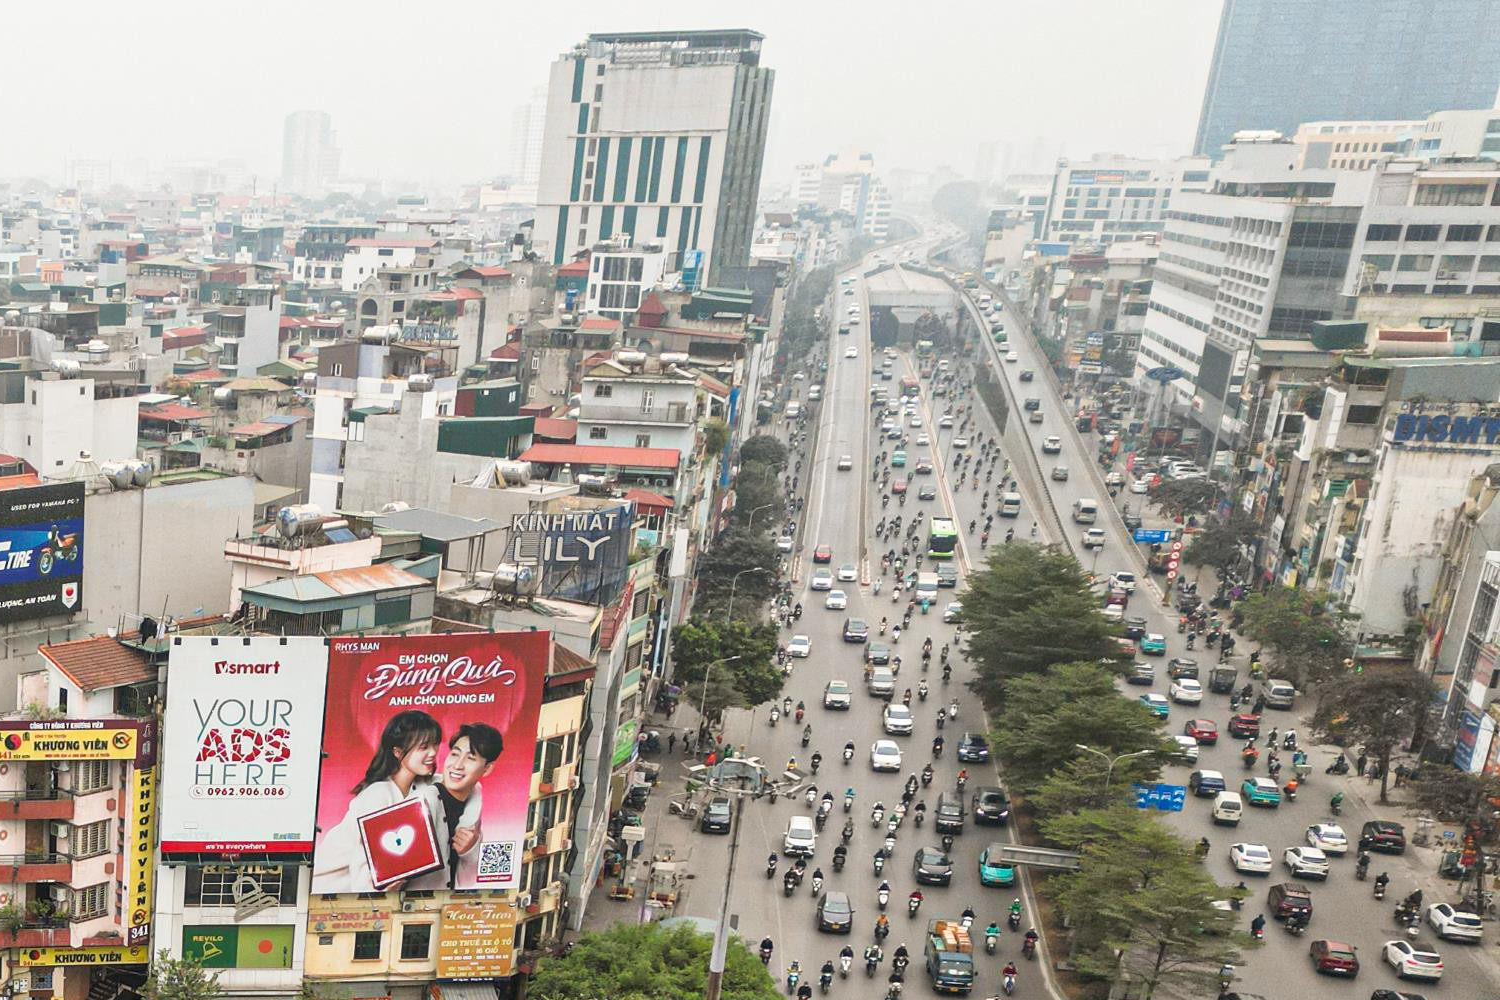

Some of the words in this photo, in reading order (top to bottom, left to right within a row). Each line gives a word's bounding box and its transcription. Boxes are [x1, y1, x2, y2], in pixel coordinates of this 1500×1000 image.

[513, 535, 611, 561] LILY
[6, 549, 34, 570] TIRE
[25, 596, 36, 606] AN
[335, 642, 358, 652] RHYS
[360, 642, 380, 651] MAN
[399, 656, 415, 664] EM
[417, 654, 448, 665] CHỌN
[363, 663, 442, 700] Đúng
[442, 654, 517, 687] Quà
[389, 696, 412, 706] ANH
[414, 695, 446, 707] CHỌN
[478, 693, 495, 703] EM
[34, 739, 80, 751] KHƯƠNG
[83, 737, 108, 750] VIÊN
[195, 728, 291, 763] ADS
[207, 787, 285, 796] 0962.906.086
[132, 924, 149, 938] 341
[55, 953, 96, 963] KHƯƠNG
[99, 952, 122, 962] VIÊN
